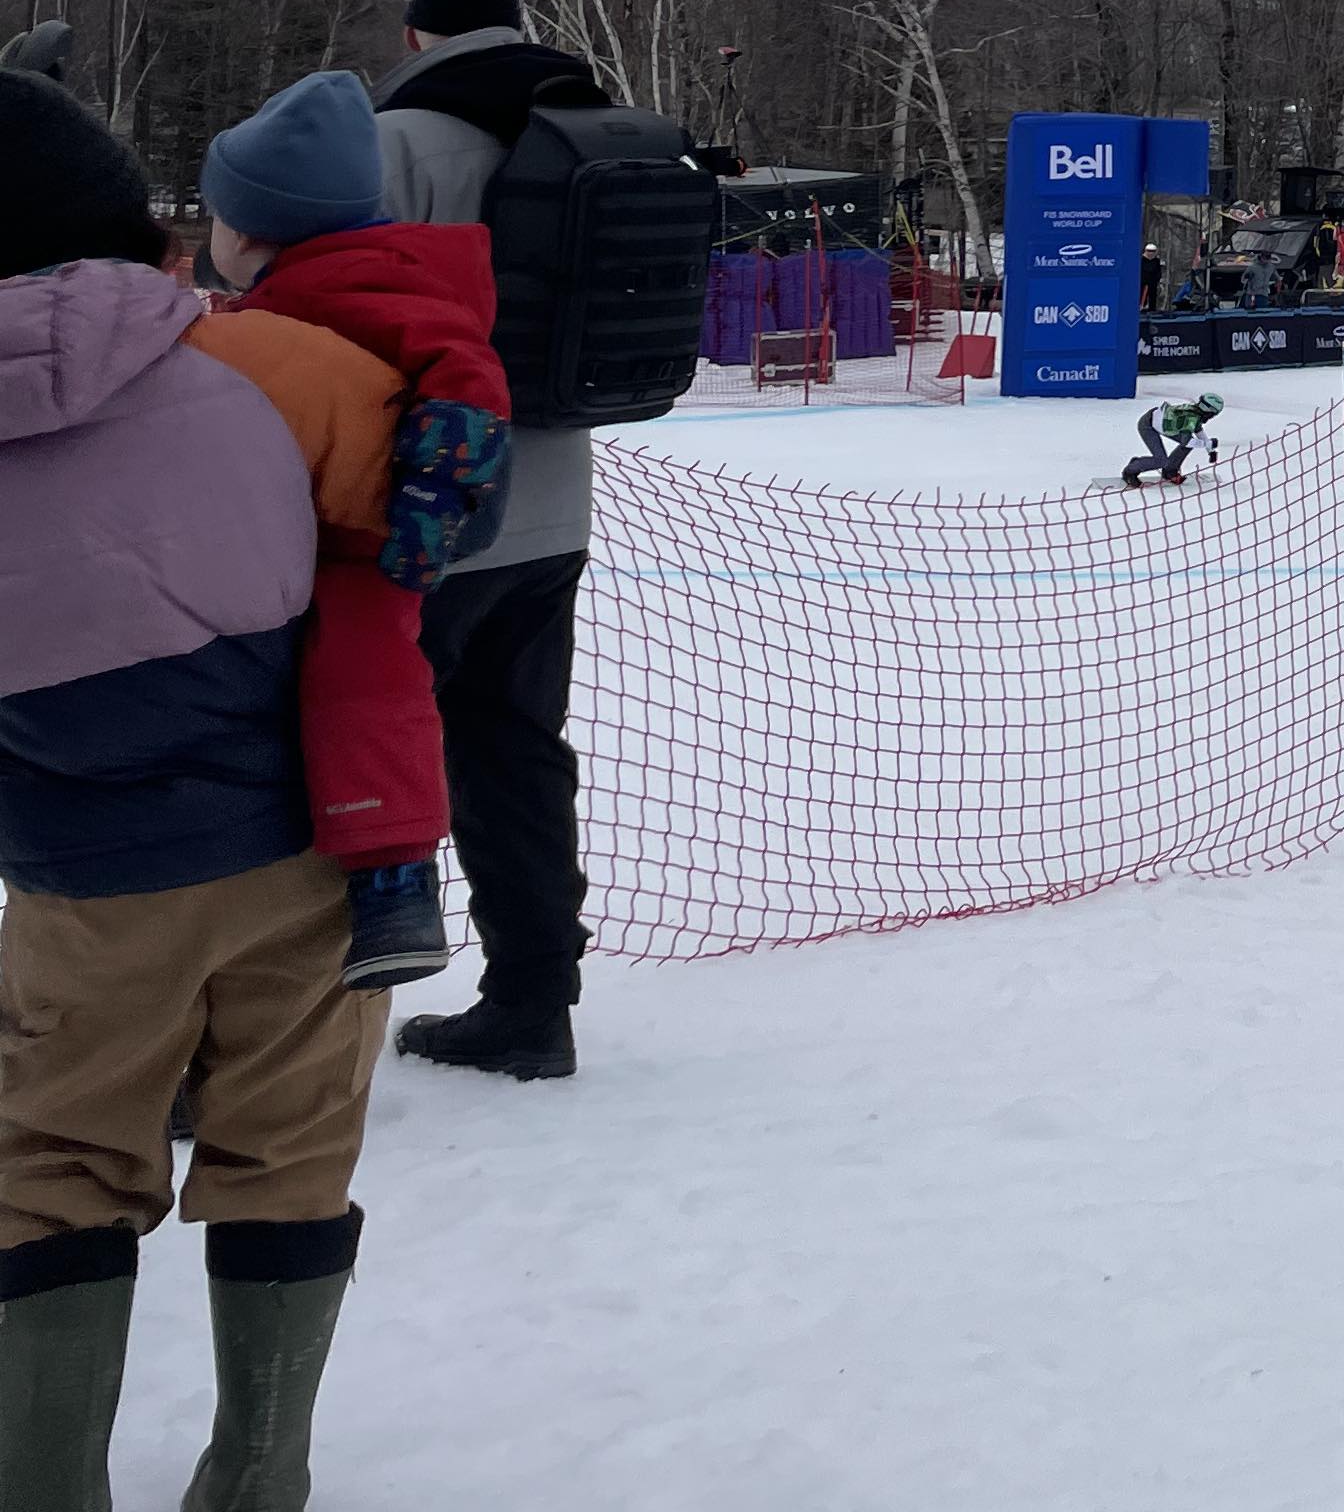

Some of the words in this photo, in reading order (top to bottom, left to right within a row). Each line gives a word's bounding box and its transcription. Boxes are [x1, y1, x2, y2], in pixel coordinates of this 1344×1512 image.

[1050, 144, 1113, 180] Bell
[765, 202, 856, 221] VOLVO
[1058, 210, 1113, 219] SNOWBOARD
[1052, 219, 1084, 228] WORLD
[1084, 219, 1103, 228] CUP
[1034, 306, 1058, 325] CAN
[1084, 305, 1109, 324] SBD
[1152, 335, 1180, 346] SHRED
[1231, 331, 1250, 352] CAN
[1153, 347, 1170, 357] THE
[1170, 345, 1200, 357] NORTH
[1037, 364, 1100, 383] Canada
